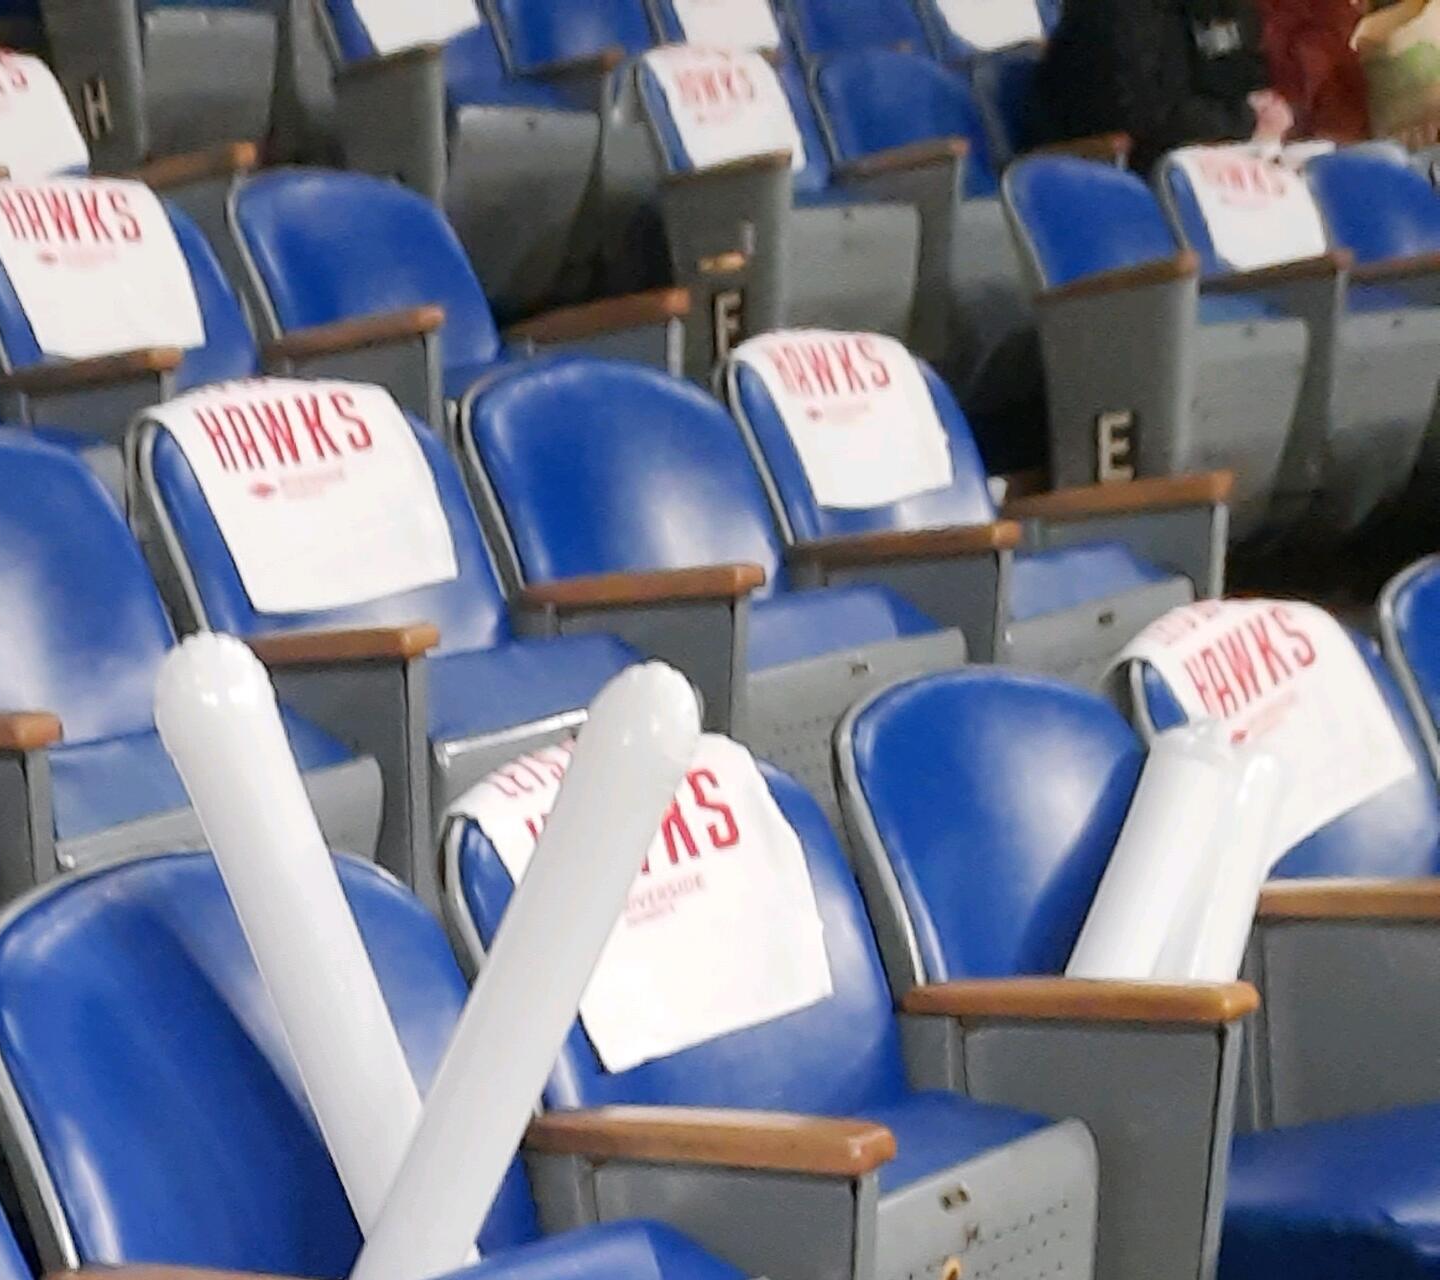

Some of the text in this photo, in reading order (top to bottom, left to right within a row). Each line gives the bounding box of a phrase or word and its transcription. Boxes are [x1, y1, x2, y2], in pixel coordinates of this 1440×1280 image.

[84, 75, 112, 140] H
[765, 337, 891, 394] HAWKS
[193, 391, 373, 470] HAWKS
[1097, 411, 1134, 483] E
[1184, 605, 1316, 718] HAWKS
